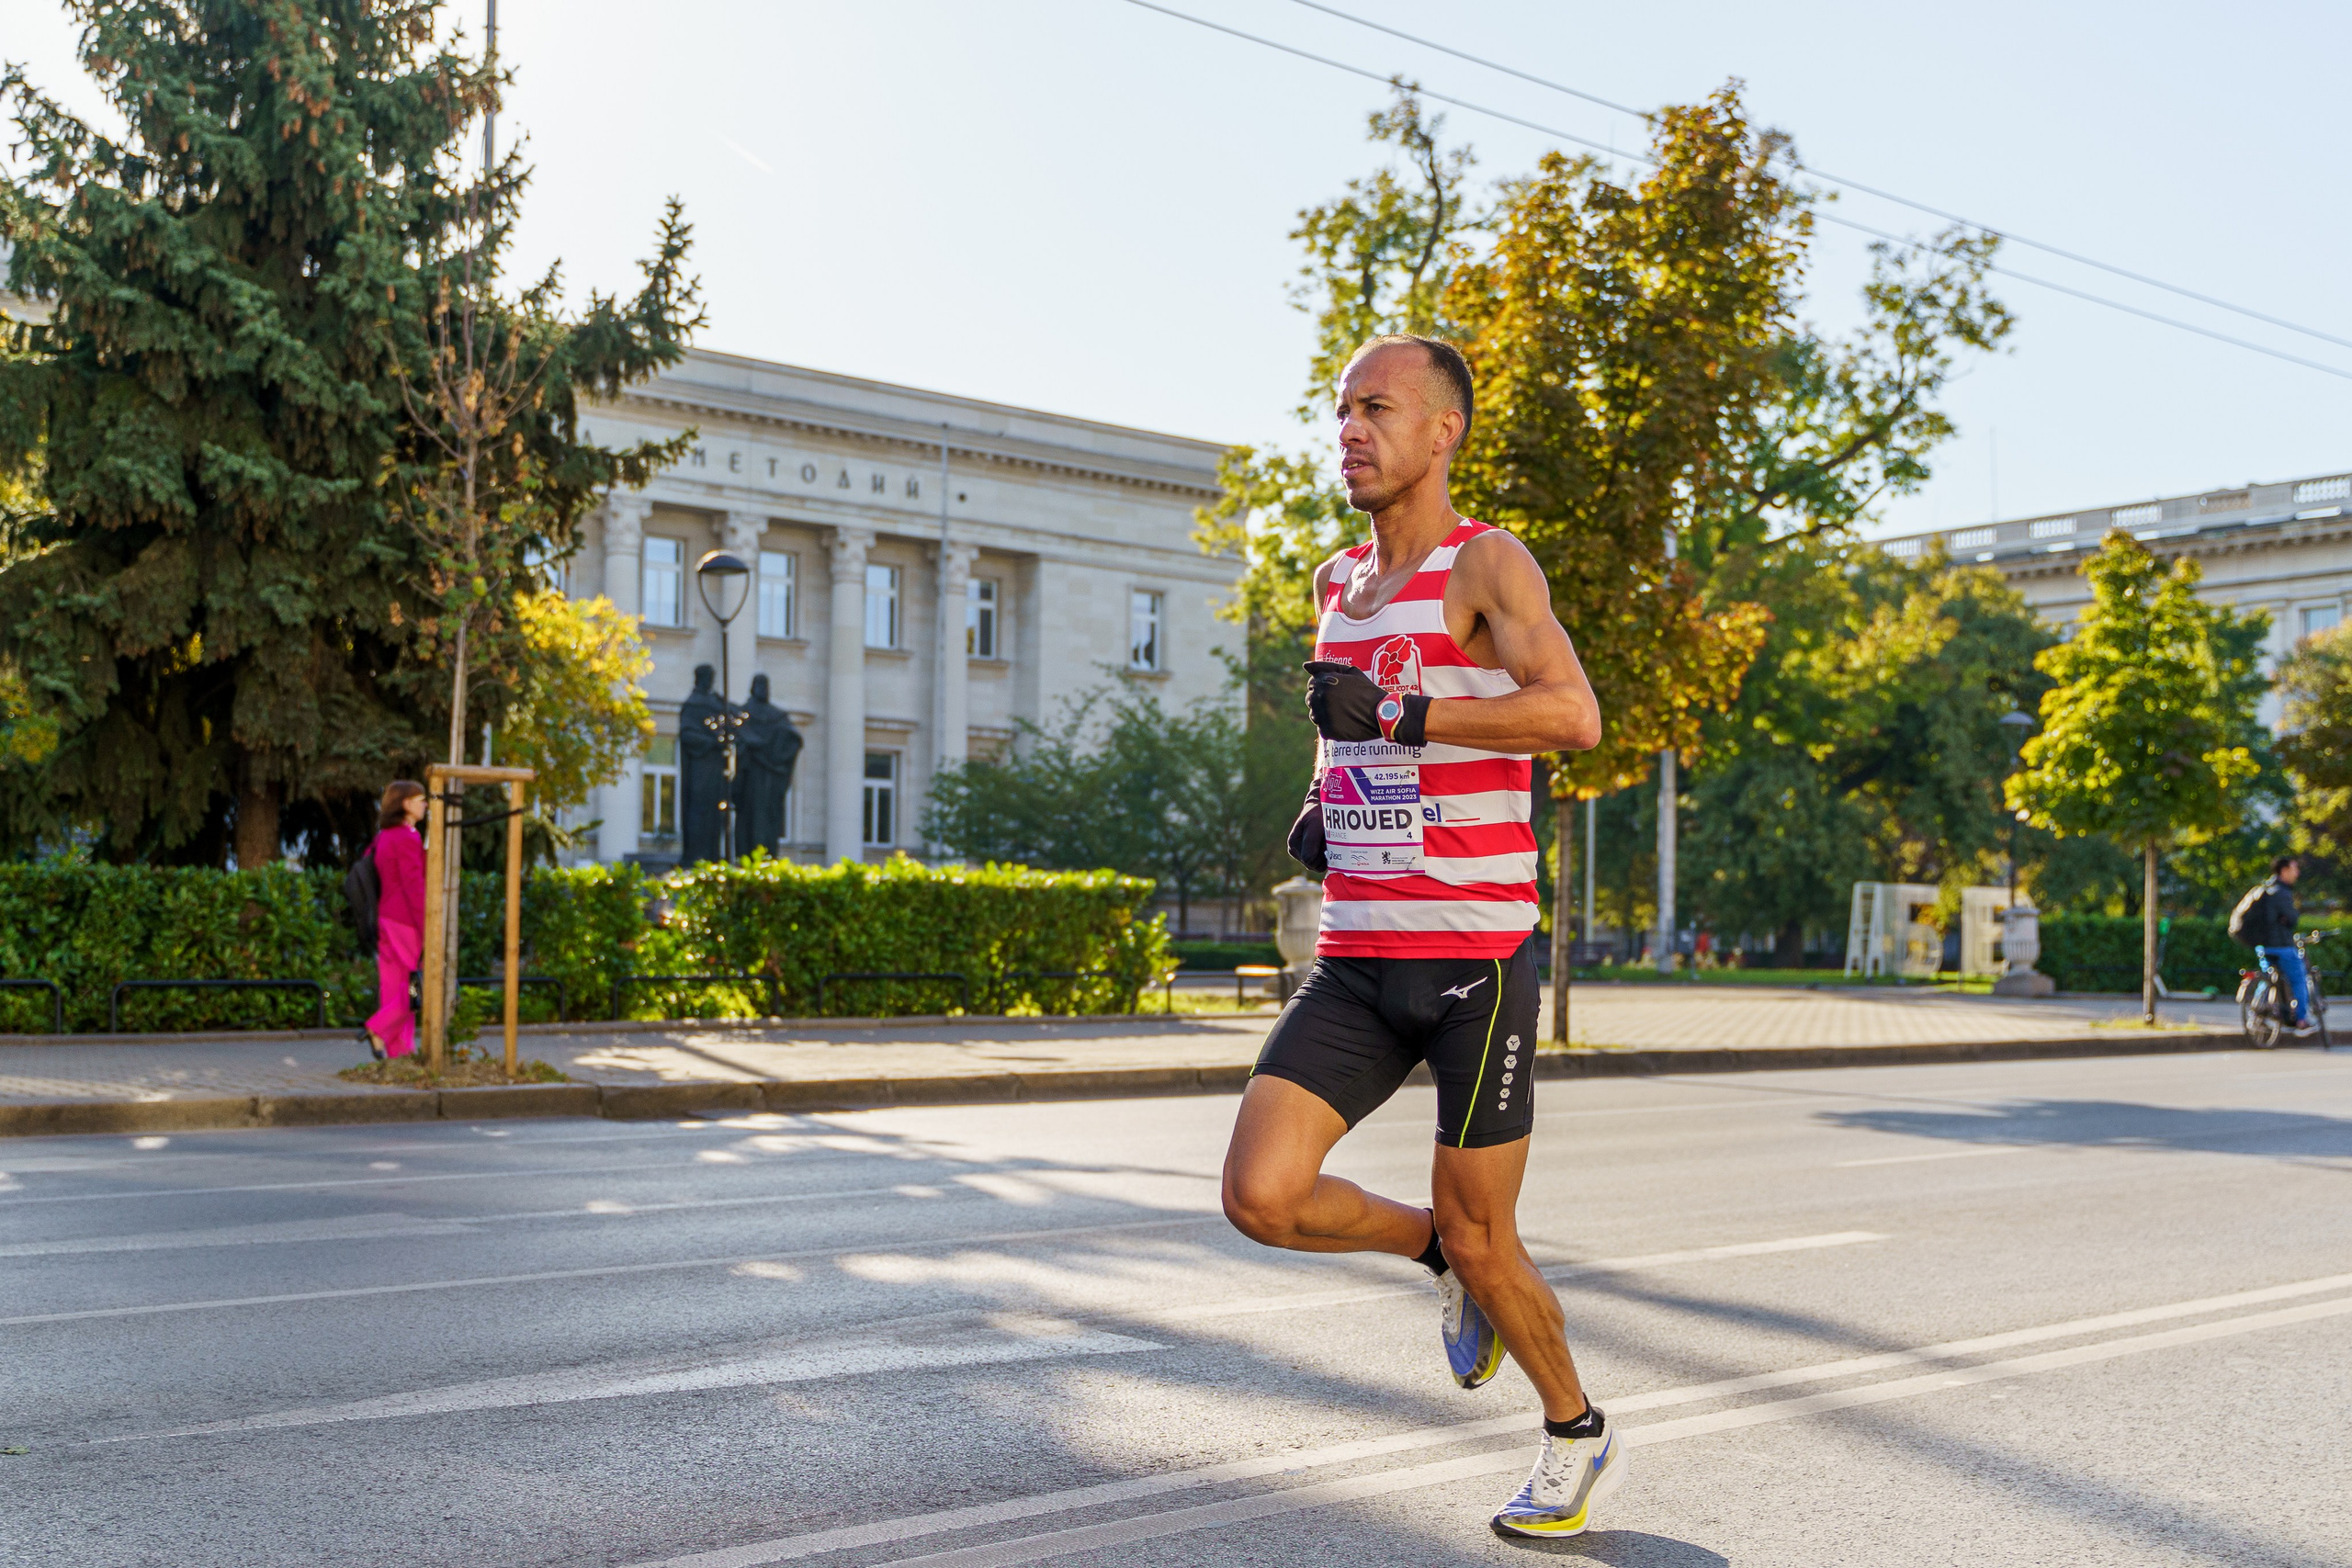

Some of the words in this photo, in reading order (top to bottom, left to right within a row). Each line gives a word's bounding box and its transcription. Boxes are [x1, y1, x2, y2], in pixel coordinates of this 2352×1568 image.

[1352, 742, 1366, 756] de
[1369, 743, 1422, 759] running
[1325, 808, 1413, 830] HRIOUED
[1329, 830, 1347, 840] FRANCE
[1407, 831, 1413, 840] 4
